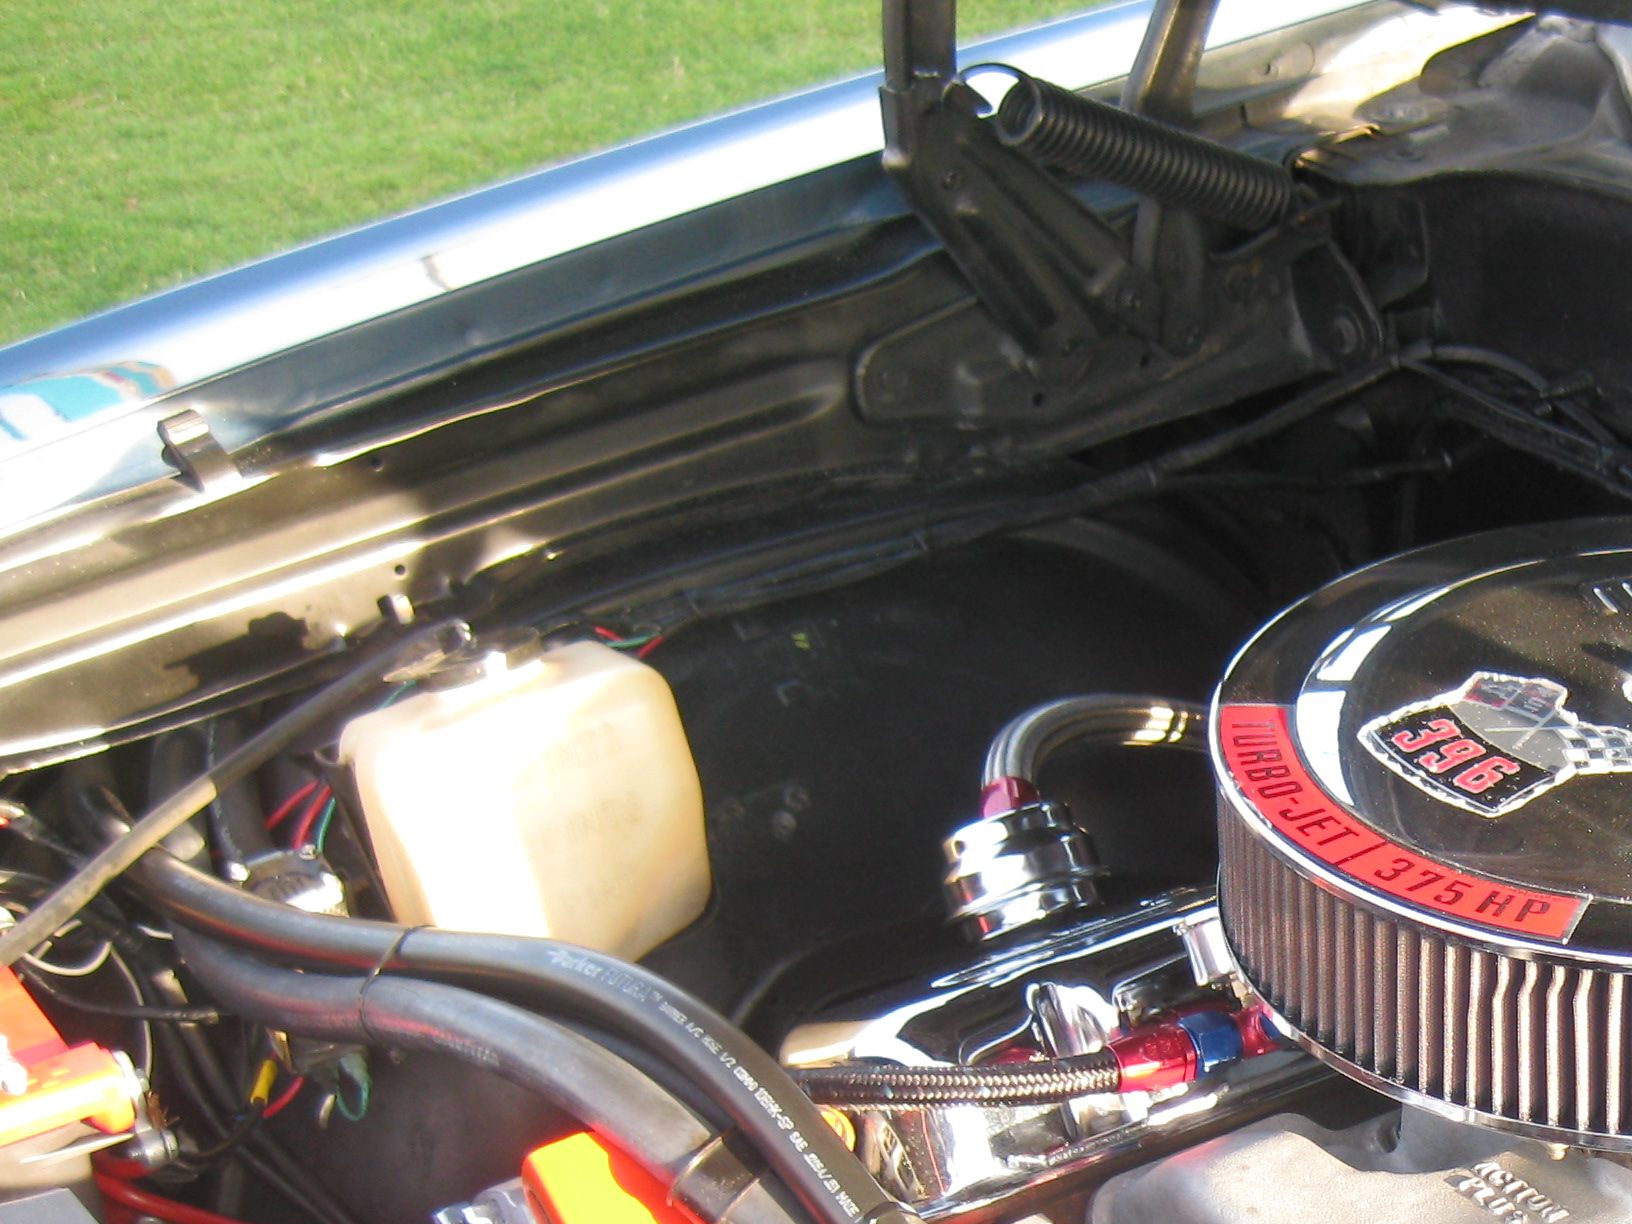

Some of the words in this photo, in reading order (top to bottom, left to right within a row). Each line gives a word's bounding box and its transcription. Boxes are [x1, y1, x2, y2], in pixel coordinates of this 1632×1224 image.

[1230, 720, 1360, 846] TURBO-JET
[1373, 857, 1474, 906] 375
[1477, 889, 1552, 923] HP
[1391, 718, 1520, 794] 396
